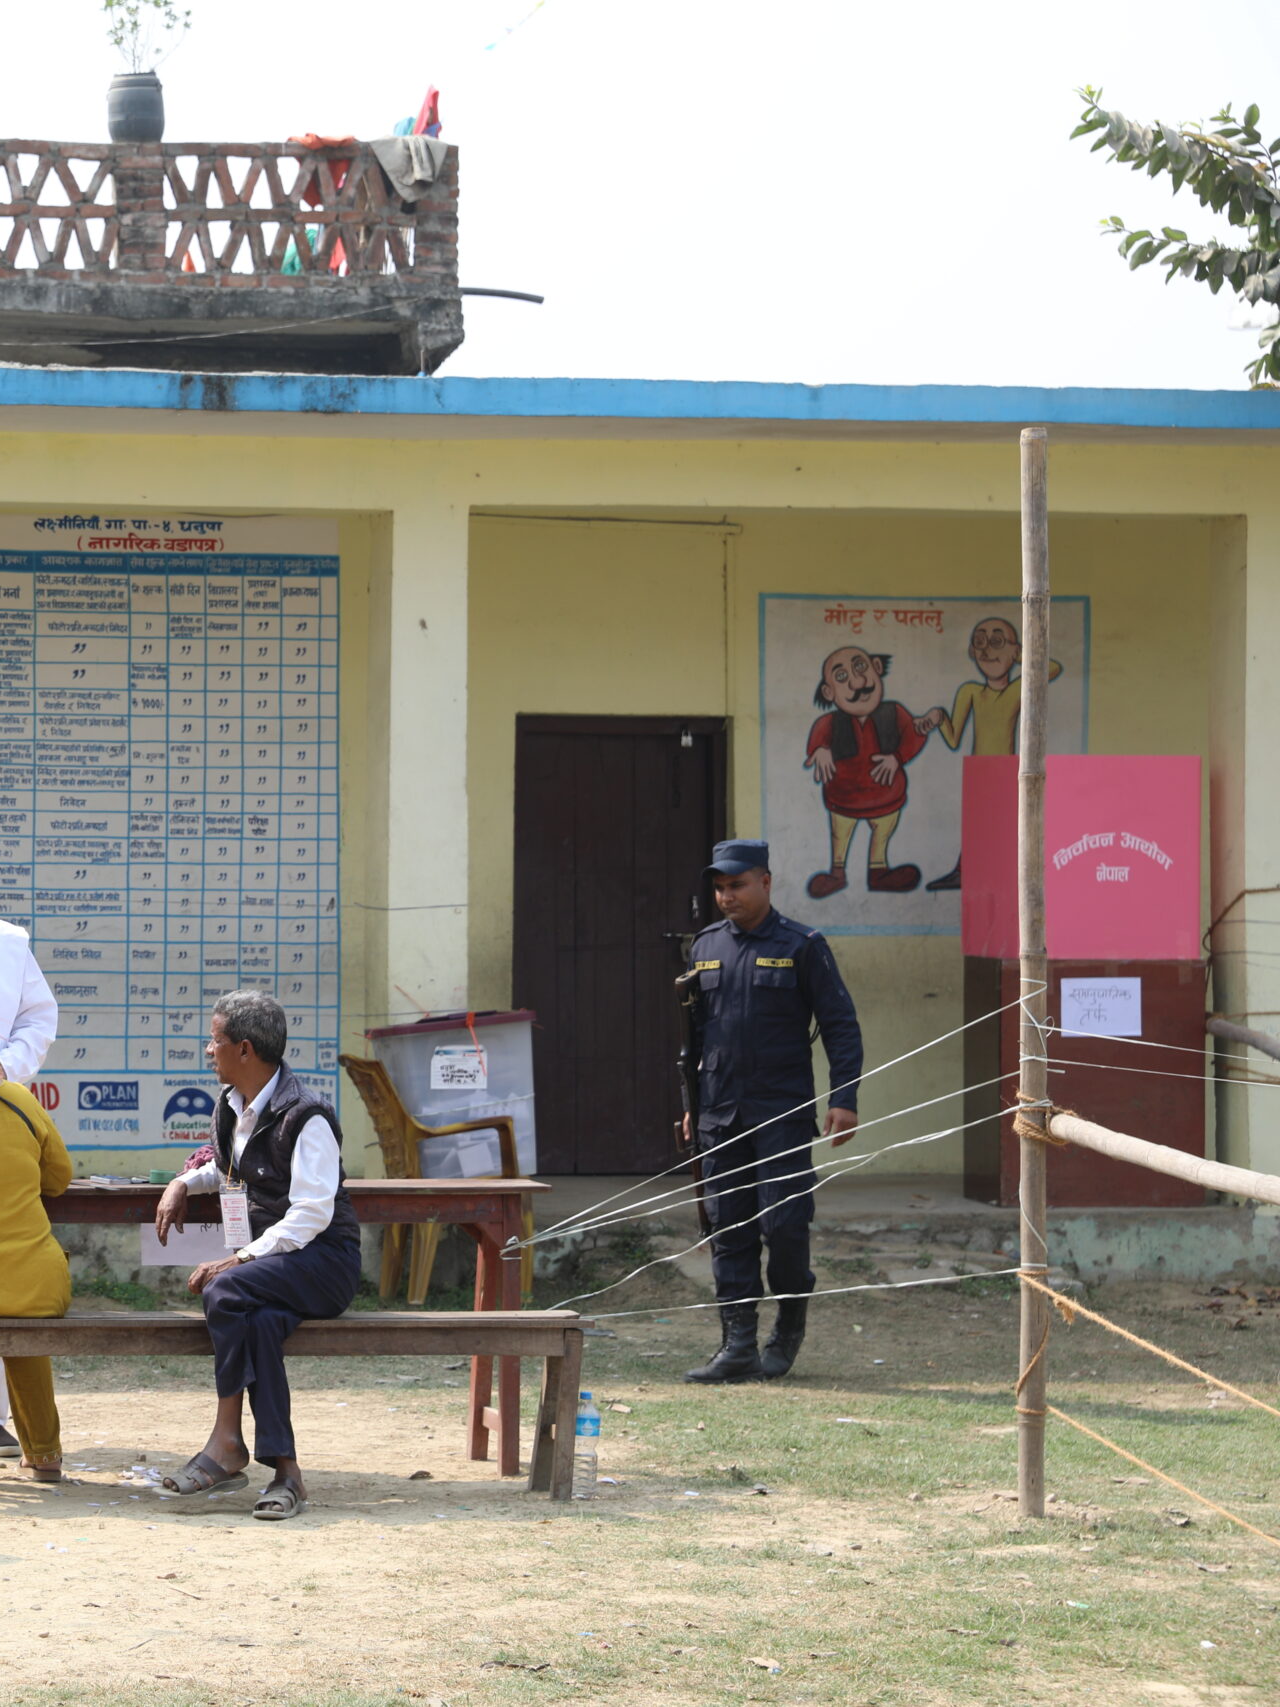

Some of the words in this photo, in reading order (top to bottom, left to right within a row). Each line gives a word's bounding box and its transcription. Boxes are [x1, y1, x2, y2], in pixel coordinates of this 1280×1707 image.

[178, 520, 223, 534] धनुषा
[872, 608, 888, 627] र
[1052, 831, 1116, 871] निर्वाचन
[1120, 831, 1174, 871] आयोग
[1095, 862, 1130, 882] नेपाल
[102, 1085, 136, 1100] PLAN
